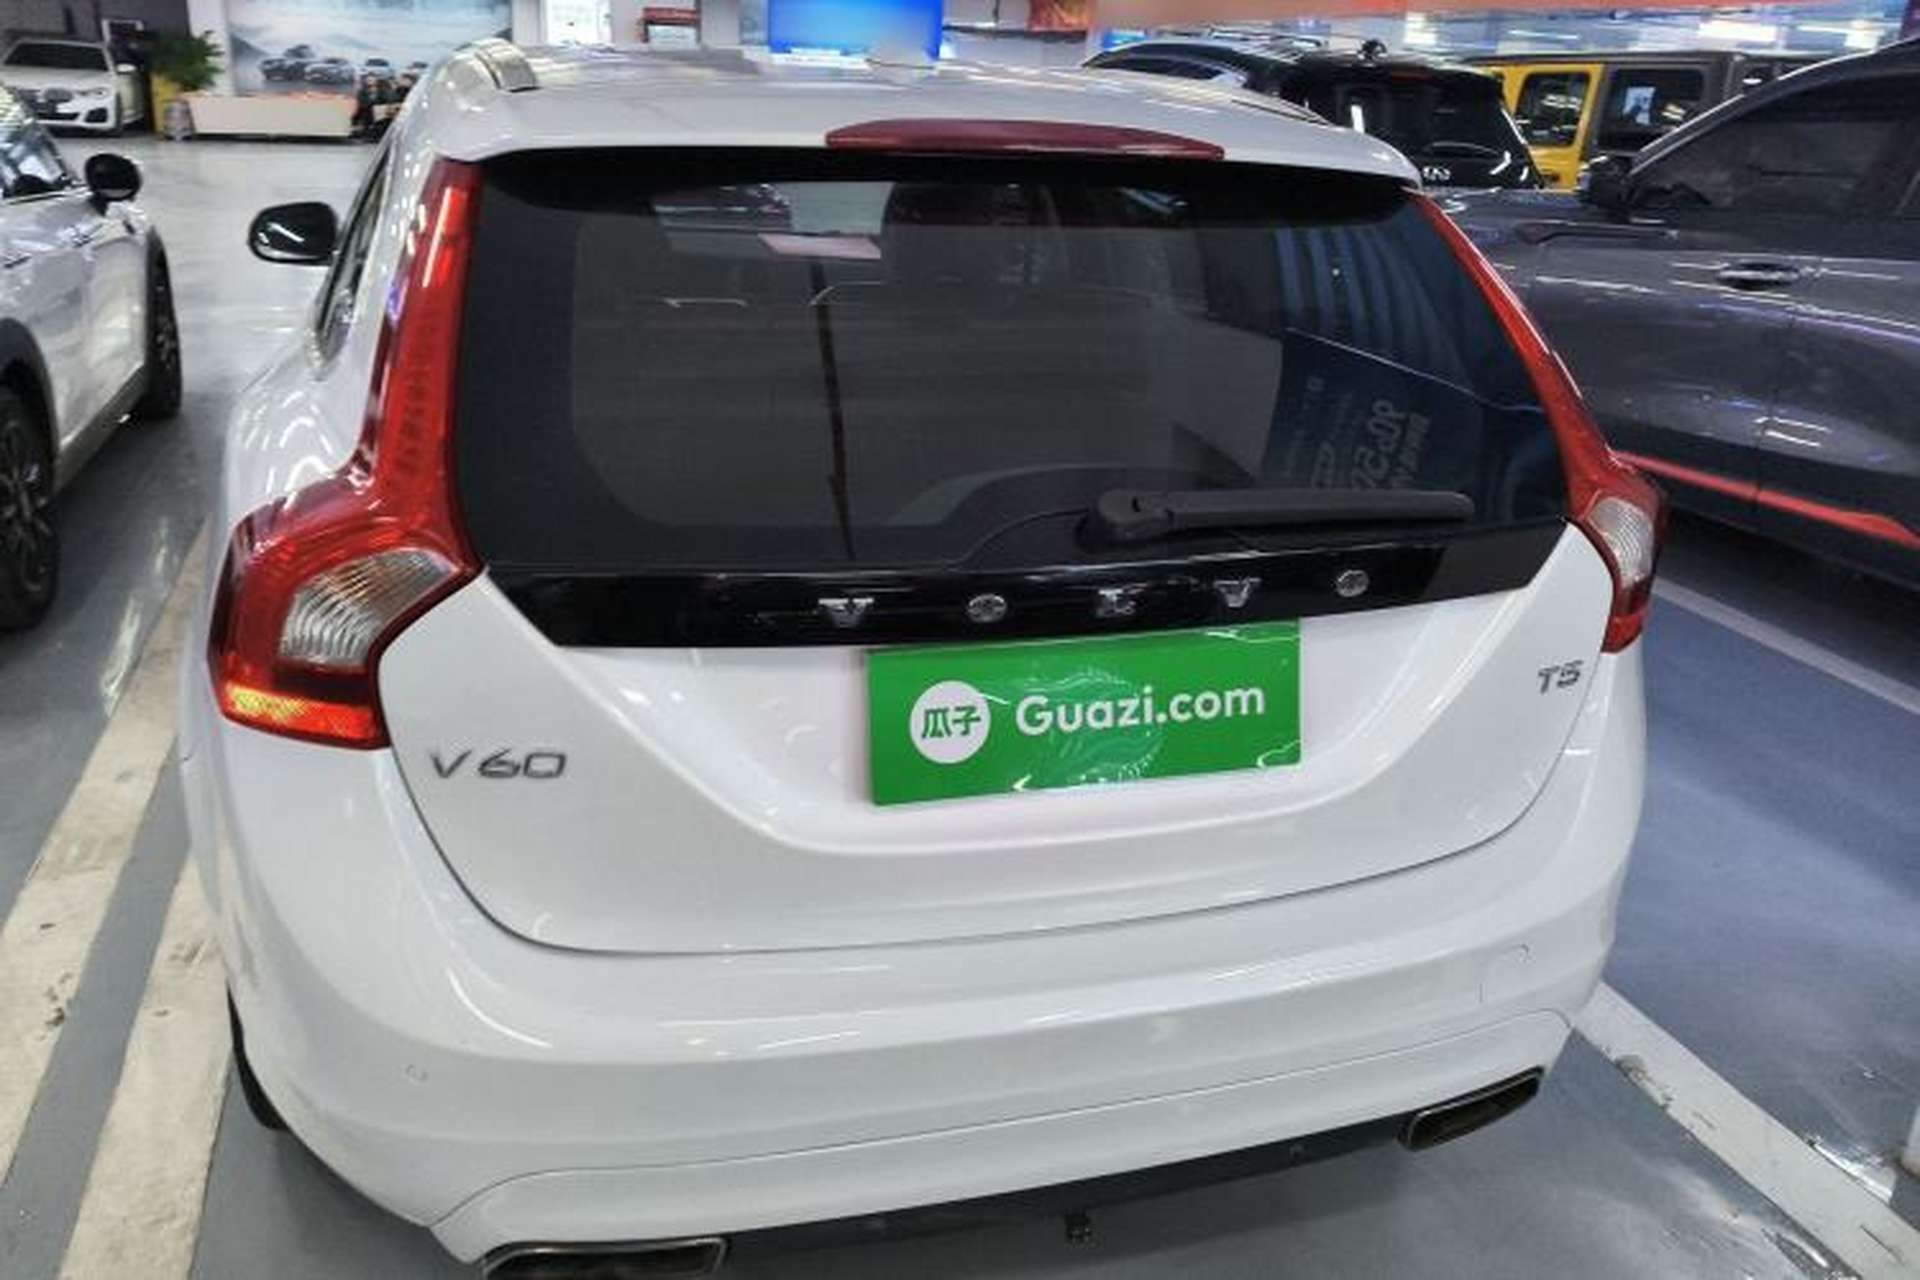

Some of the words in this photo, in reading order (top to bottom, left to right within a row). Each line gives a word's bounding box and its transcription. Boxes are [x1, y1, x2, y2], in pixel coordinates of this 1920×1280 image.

[921, 704, 982, 740] 瓜子
[1016, 685, 1266, 736] Guazi.com
[430, 748, 567, 779] V60
